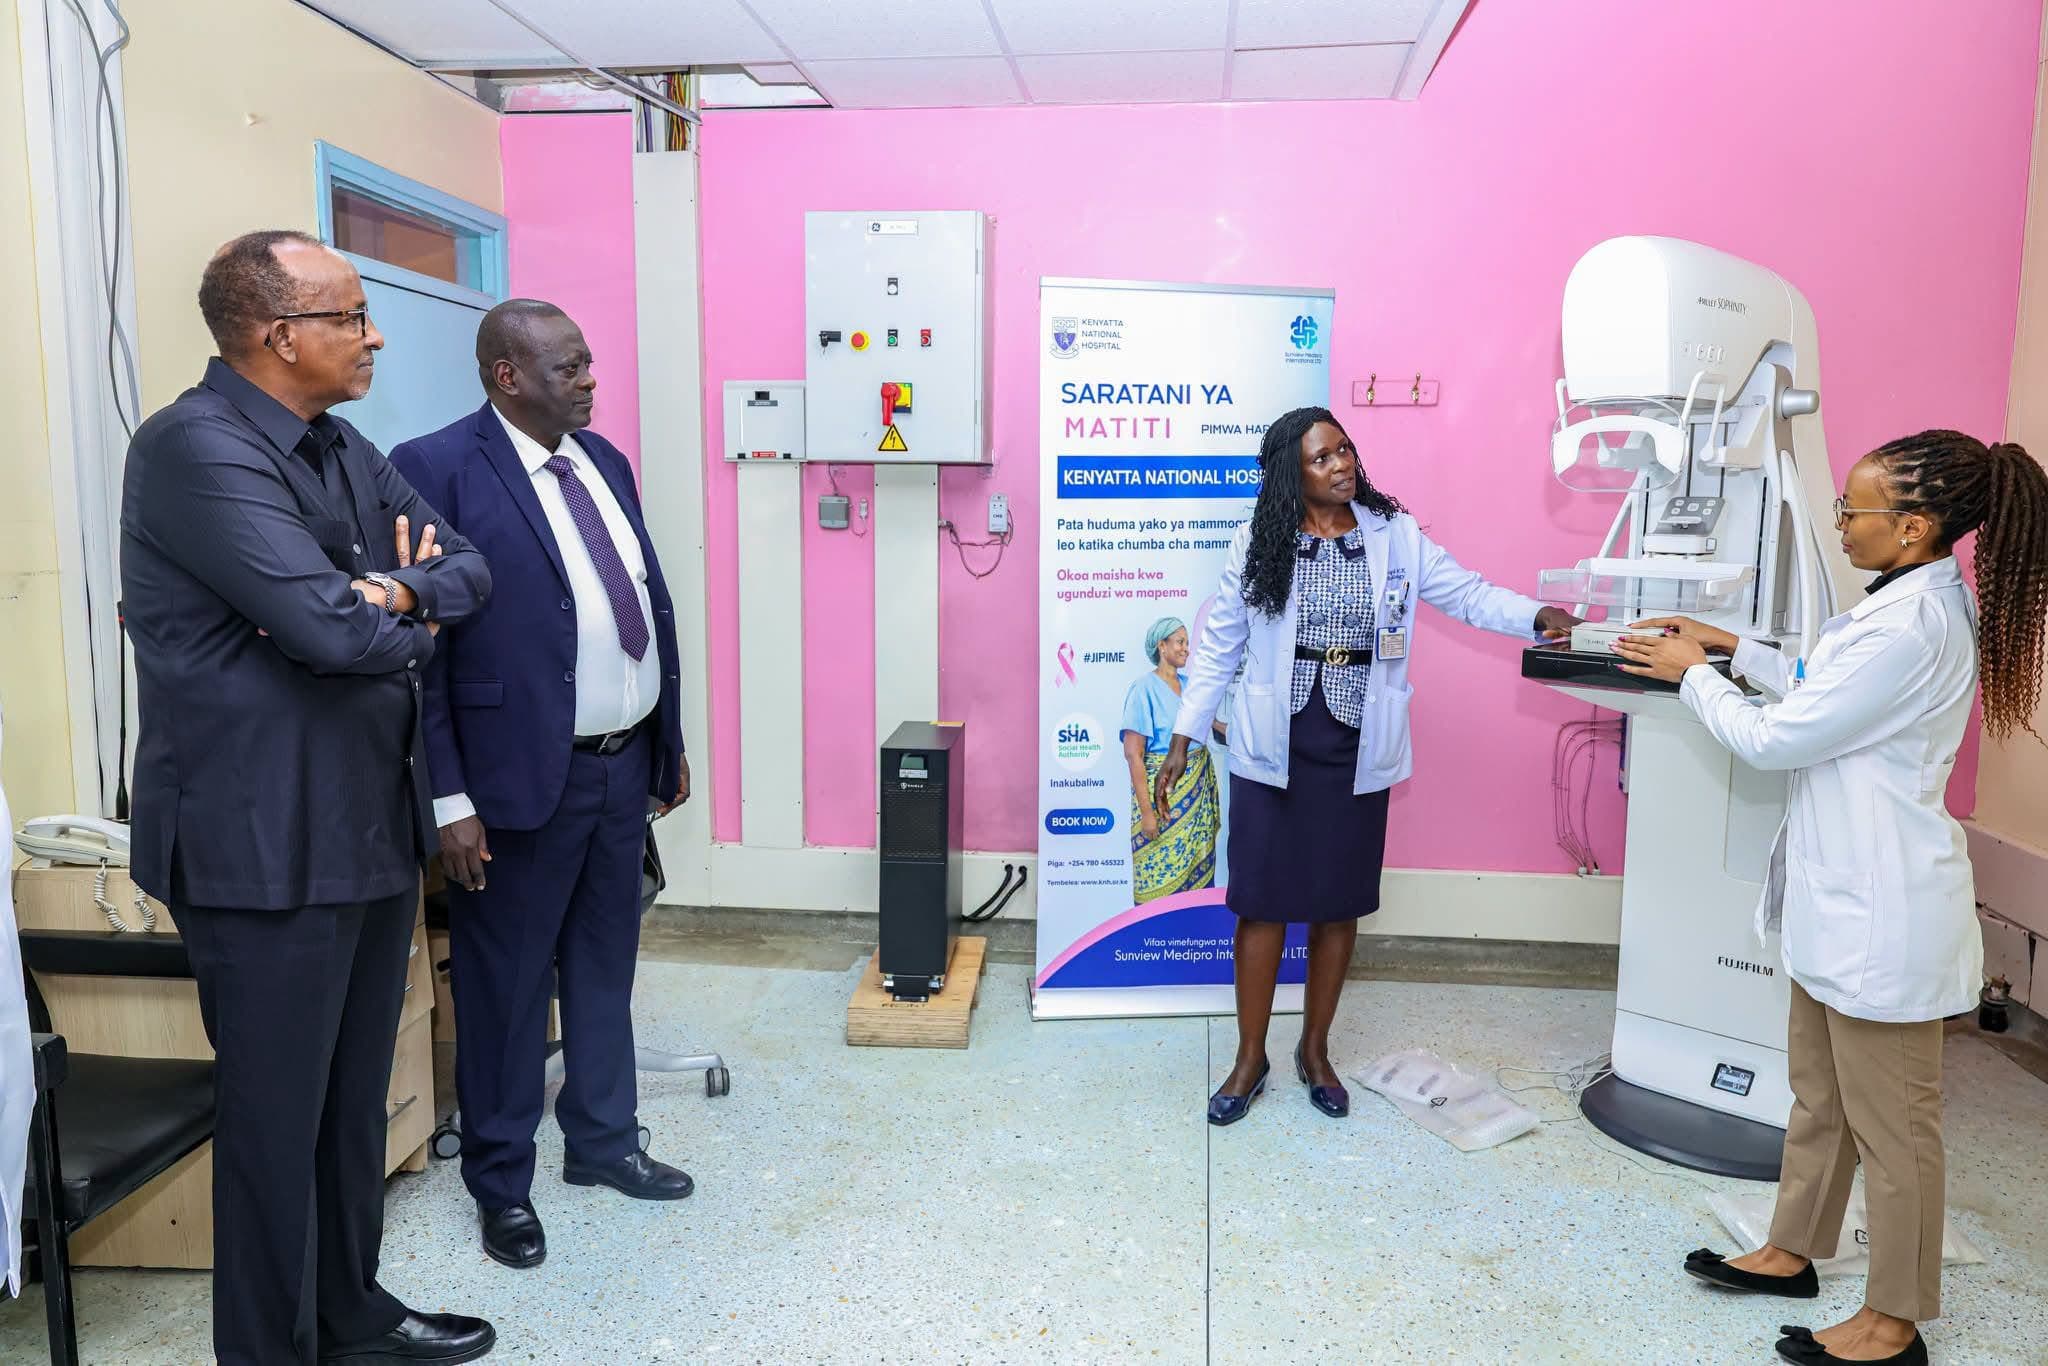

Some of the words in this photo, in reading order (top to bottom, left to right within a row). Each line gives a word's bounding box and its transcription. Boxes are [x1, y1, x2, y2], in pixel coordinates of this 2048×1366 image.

[1082, 318, 1124, 327] KENYATTA
[1082, 330, 1122, 338] NATIONAL
[1082, 342, 1121, 350] HOSPITAL
[1062, 383, 1191, 404] SARATANI
[1201, 384, 1234, 404] YA
[1065, 417, 1170, 438] MATITI
[1202, 424, 1242, 434] PIMWA
[1064, 470, 1141, 486] KENYATTA
[1146, 470, 1221, 485] NATIONAL
[1058, 518, 1083, 530] Pata
[1088, 518, 1137, 530] huduma
[1140, 518, 1167, 532] yako
[1171, 520, 1184, 532] ya
[1058, 540, 1075, 550] leo
[1079, 539, 1114, 550] katika
[1118, 539, 1165, 550] chumba
[1168, 539, 1190, 549] cha
[1057, 569, 1089, 581] Okoa
[1092, 568, 1135, 580] maisha
[1138, 570, 1164, 580] kwa
[1057, 588, 1111, 601] ugunduzi
[1115, 589, 1132, 598] wa
[1137, 589, 1188, 600] mapema
[1084, 652, 1125, 663] #JIPIME
[1058, 725, 1090, 742] SHA
[1050, 778, 1105, 788] Inakubaliwa
[1052, 817, 1079, 827] BOOK
[1082, 816, 1108, 826] NOW
[1144, 938, 1166, 946] Vifaa
[1167, 938, 1216, 948] vimefungwa
[1115, 950, 1160, 961] Sunview
[1164, 950, 1213, 963] Medipro
[1718, 956, 1774, 977] FUJIFILM
